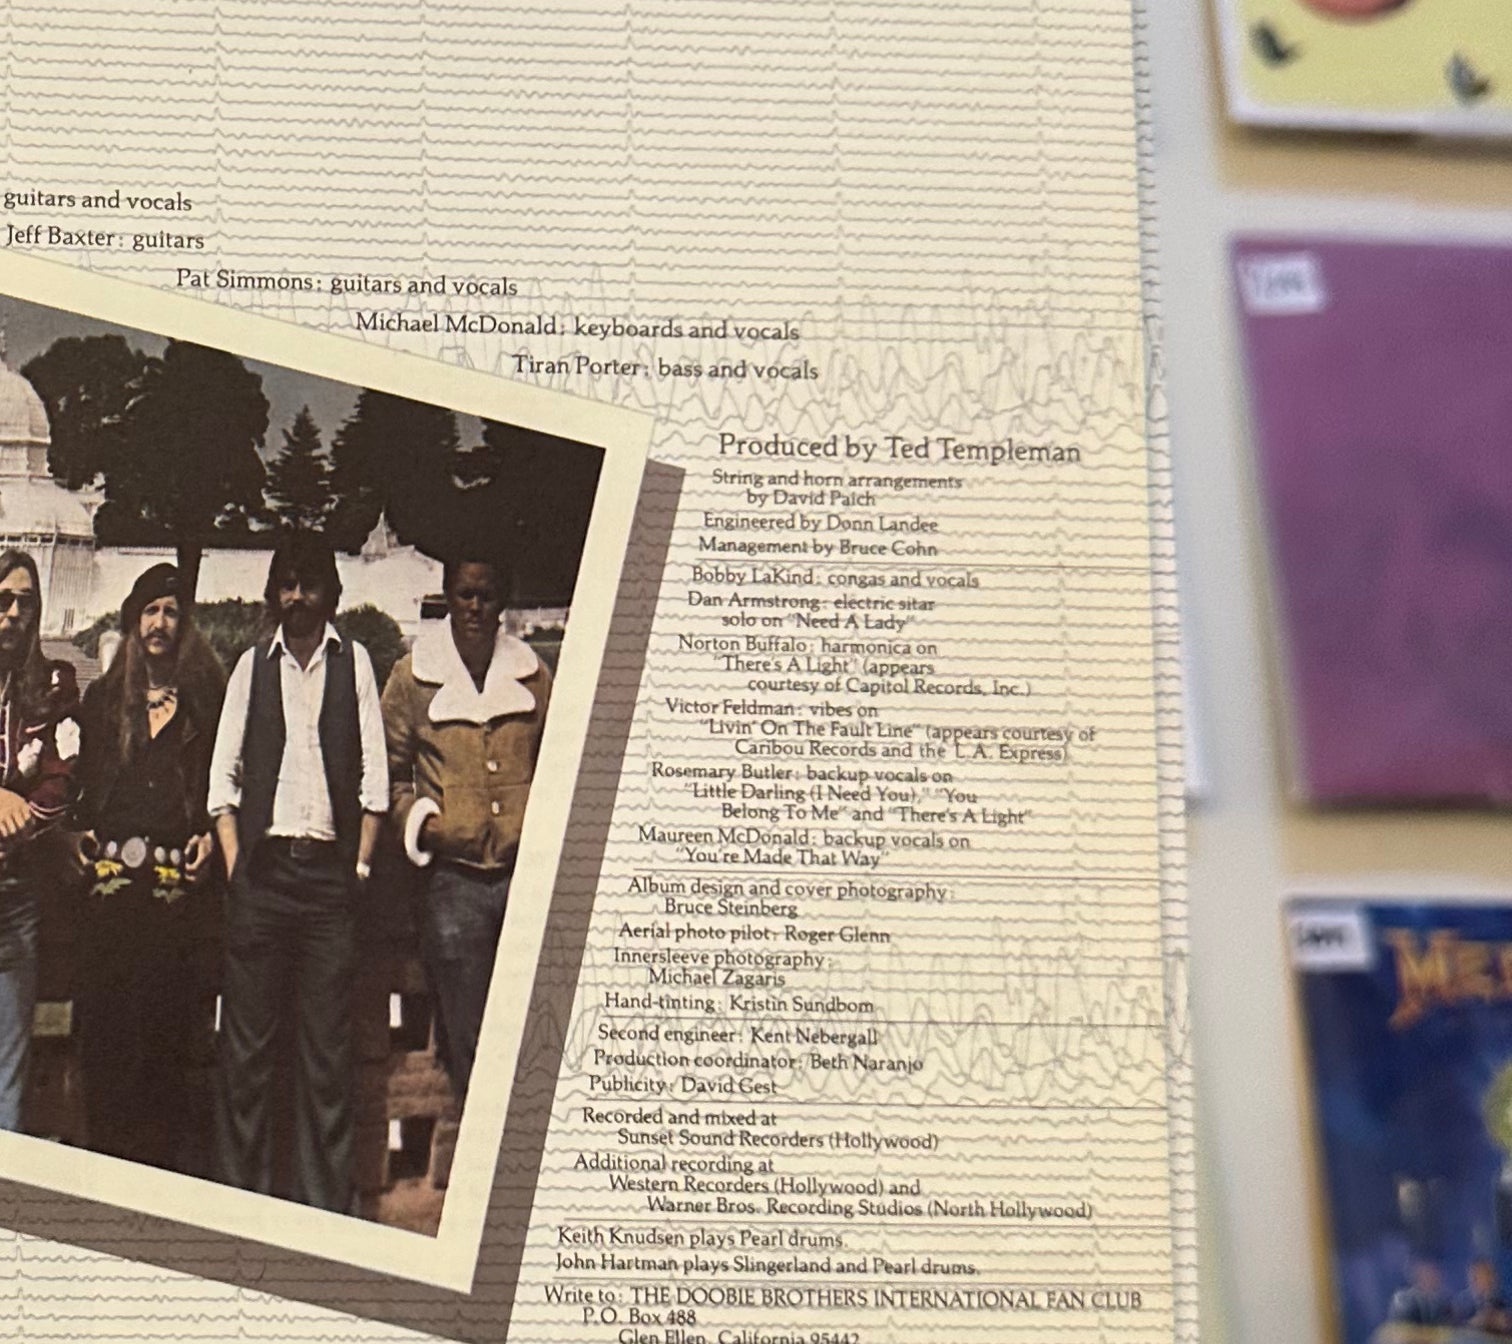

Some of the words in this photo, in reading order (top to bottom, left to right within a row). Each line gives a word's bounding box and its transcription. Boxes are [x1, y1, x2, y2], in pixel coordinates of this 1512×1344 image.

[3, 186, 76, 212] guitars
[82, 189, 120, 209] and
[126, 191, 193, 212] vocals
[6, 225, 43, 249] Jeff
[47, 226, 124, 248] Baxter:
[132, 228, 205, 255] guitars
[176, 269, 210, 290] Pat
[215, 270, 321, 292] Simmons:
[330, 273, 402, 299] guitars
[408, 275, 446, 295] and
[452, 276, 518, 297] vocals
[356, 311, 438, 333] Michael
[444, 313, 567, 336] McDonald:
[574, 316, 683, 343] keyboards
[688, 319, 728, 340] and
[734, 321, 800, 341] vocals
[512, 354, 571, 375] Tiran
[576, 355, 649, 377] Porter:
[658, 357, 703, 378] bass
[708, 359, 747, 379] and
[753, 360, 818, 381] vocals
[719, 434, 838, 458] Produced
[845, 436, 877, 465] by
[886, 436, 929, 459] Ted
[936, 437, 1080, 467] Templeman
[712, 469, 764, 490] String
[767, 470, 799, 486] and
[804, 471, 843, 486] horn
[848, 476, 963, 493] arrangements
[747, 489, 767, 510] by
[773, 490, 825, 506] David
[830, 491, 875, 507] Paich
[703, 512, 795, 534] Engineered
[799, 514, 822, 536] by
[827, 514, 874, 531] Donn
[879, 515, 938, 532] Landee
[699, 536, 808, 559] Management
[812, 538, 834, 560] by
[839, 539, 887, 556] Bruce
[892, 540, 937, 556] Cohn
[628, 877, 686, 894] Album
[691, 878, 744, 901] design
[749, 880, 780, 896] and
[784, 885, 832, 897] cover
[837, 881, 953, 905] photography:
[664, 898, 713, 914] Bruce
[717, 899, 798, 921] Steinberg
[648, 968, 717, 985] Michael
[722, 969, 786, 991] Zagaris
[605, 993, 723, 1016] Hand-tinting:
[730, 995, 788, 1012] Kristin
[792, 996, 873, 1013] Sundbom
[598, 1025, 659, 1042] Second
[664, 1026, 743, 1048] engineer:
[750, 1027, 792, 1044] Kent
[797, 1028, 878, 1050] Nebergall
[593, 1050, 690, 1067] Production
[694, 1052, 803, 1069] coordinator:
[810, 1053, 848, 1070] Beth
[853, 1054, 924, 1076] Naranjo
[582, 1107, 663, 1125] Recorded
[668, 1108, 700, 1126] and
[705, 1108, 756, 1126] mixed
[760, 1112, 776, 1126] at
[618, 1129, 674, 1146] Sunset
[678, 1130, 734, 1147] Sound
[739, 1131, 824, 1148] Recorders
[828, 1132, 940, 1154] (Hollywood)
[573, 1154, 666, 1172] Additional
[671, 1155, 753, 1178] recording
[758, 1159, 774, 1173] at
[608, 1175, 678, 1192] Western
[684, 1176, 769, 1193] Recorders
[773, 1177, 884, 1200] (Hollywood)
[888, 1178, 920, 1195] and
[646, 1196, 712, 1214] Warner
[716, 1197, 760, 1214] Bros.
[767, 1198, 854, 1221] Recording
[858, 1199, 922, 1216] Studios
[927, 1199, 985, 1220] (North
[990, 1200, 1094, 1223] Hollywood)
[558, 1228, 604, 1245] Keith
[608, 1228, 684, 1246] Knudsen
[689, 1229, 734, 1252] plays
[740, 1229, 783, 1247] Pearl
[788, 1230, 848, 1248] drums.
[556, 1254, 597, 1271] John
[601, 1254, 678, 1272] Hartman
[682, 1255, 728, 1278] plays
[733, 1255, 831, 1279] Slingerland
[836, 1257, 868, 1274] and
[873, 1257, 916, 1275] Pearl
[922, 1257, 980, 1275] drums.
[544, 1286, 594, 1303] Write
[598, 1289, 623, 1304] to:
[630, 1286, 672, 1304] THE
[676, 1287, 757, 1305] DOOBIE
[762, 1288, 868, 1306] BROTHERS
[874, 1289, 1042, 1308] INTERNATIONAL
[1046, 1291, 1086, 1309] FAN
[1091, 1292, 1142, 1309] CLUB
[582, 1308, 623, 1324] P.O.
[628, 1308, 662, 1325] Box
[667, 1308, 696, 1325] 488
